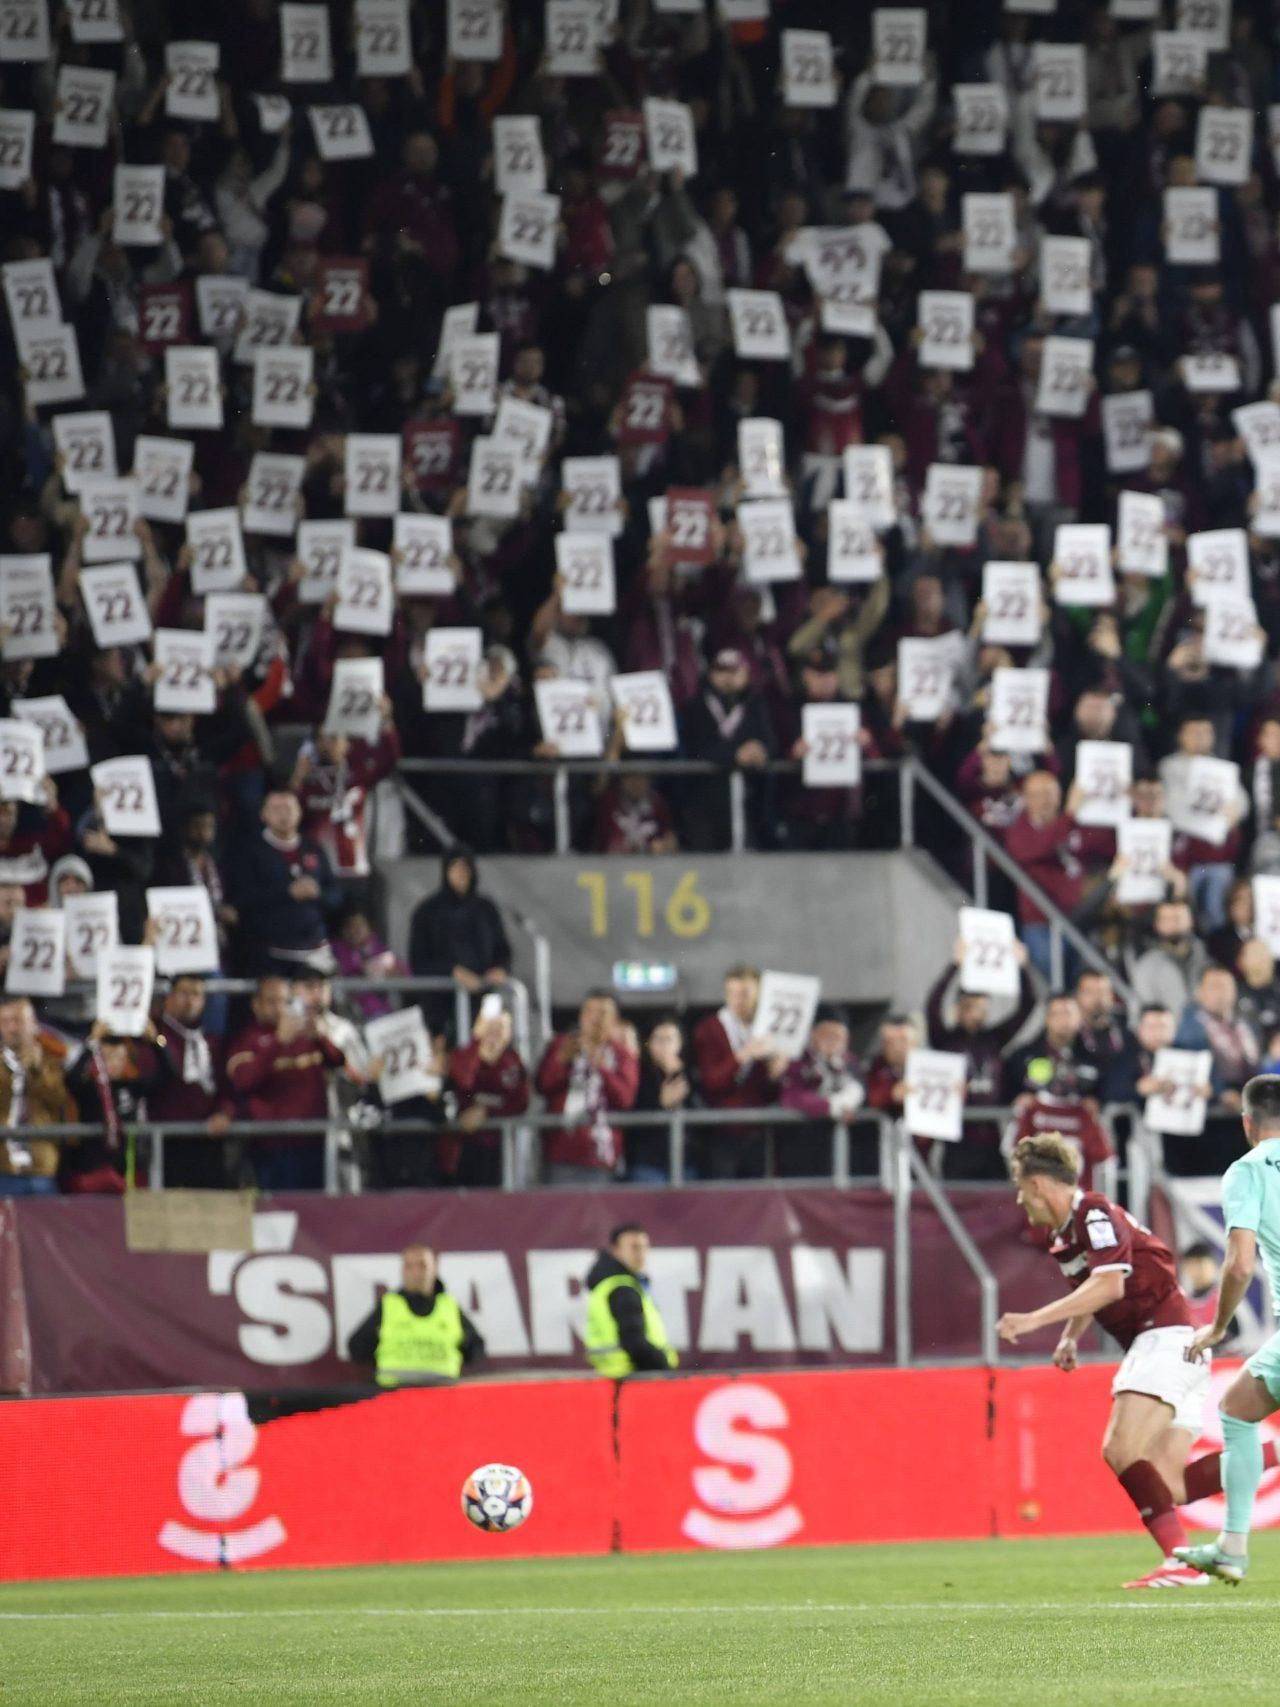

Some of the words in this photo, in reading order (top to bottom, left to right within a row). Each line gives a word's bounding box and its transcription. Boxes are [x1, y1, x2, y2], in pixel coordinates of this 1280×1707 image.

[6, 12, 37, 39] 22
[458, 12, 489, 37] 22
[556, 24, 588, 53] 22
[289, 32, 319, 59] 22
[366, 26, 398, 53] 22
[882, 35, 915, 63] 22
[174, 69, 209, 97] 22
[795, 55, 824, 84] 22
[67, 95, 98, 124] 22
[325, 108, 357, 136] 22
[964, 106, 994, 133] 22
[606, 134, 639, 162] 22
[658, 125, 684, 152] 22
[1207, 134, 1240, 162] 22
[506, 143, 533, 173] 22
[126, 193, 154, 221] 22
[513, 216, 544, 243] 22
[20, 288, 51, 317] 22
[325, 282, 361, 314] 22
[146, 307, 180, 340] 22
[252, 317, 286, 343] 22
[929, 316, 961, 344] 22
[30, 351, 67, 380] 22
[463, 362, 487, 389] 22
[181, 374, 211, 401] 22
[266, 374, 299, 400] 22
[628, 397, 663, 427] 22
[69, 442, 104, 468] 22
[414, 442, 452, 472] 22
[148, 468, 179, 495] 22
[357, 464, 391, 493] 22
[480, 464, 513, 493] 22
[259, 480, 289, 511] 22
[573, 486, 607, 513] 22
[937, 495, 967, 523] 22
[93, 509, 128, 537] 22
[670, 511, 707, 547] 22
[202, 539, 234, 568] 22
[406, 541, 441, 570] 22
[841, 527, 870, 557] 22
[569, 561, 602, 589] 22
[1066, 551, 1098, 578] 22
[350, 578, 382, 608] 22
[995, 590, 1029, 618] 22
[9, 606, 43, 635] 22
[101, 594, 134, 623] 22
[217, 622, 252, 651] 22
[168, 660, 200, 686] 22
[435, 657, 467, 685] 22
[340, 689, 373, 716] 22
[628, 700, 660, 727] 22
[1007, 703, 1035, 727] 22
[552, 705, 586, 733] 22
[43, 719, 70, 749] 22
[817, 732, 848, 762] 22
[2, 750, 33, 776] 22
[110, 784, 144, 814] 22
[577, 871, 712, 938] 116
[165, 918, 199, 946] 22
[24, 944, 56, 971] 22
[972, 940, 1007, 969] 22
[110, 977, 144, 1007] 22
[770, 1005, 802, 1036] 22
[384, 1041, 418, 1076] 22
[918, 1087, 948, 1111] 22
